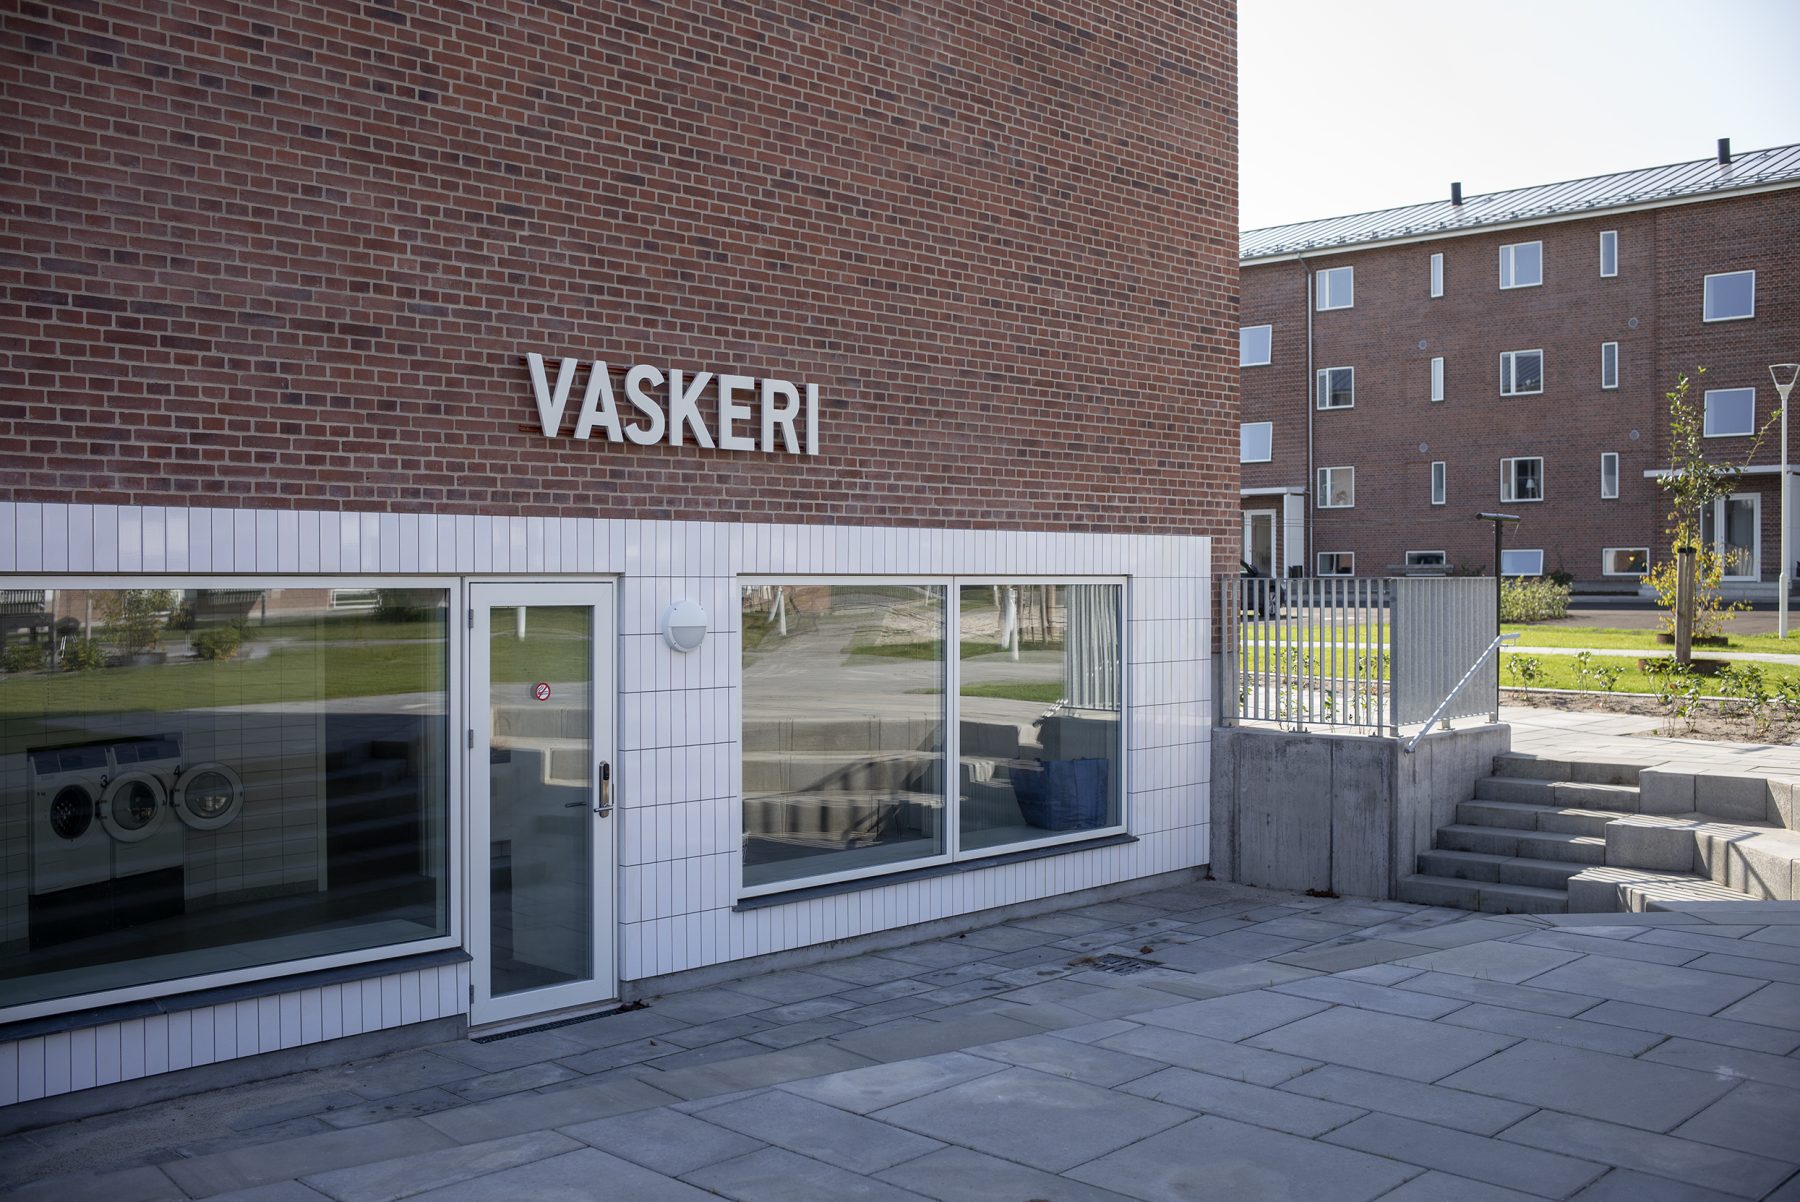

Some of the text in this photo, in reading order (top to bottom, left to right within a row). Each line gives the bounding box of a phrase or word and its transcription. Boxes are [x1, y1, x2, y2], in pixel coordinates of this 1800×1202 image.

[526, 352, 819, 455] VASKERI
[173, 764, 181, 777] 4
[100, 774, 108, 788] 3
